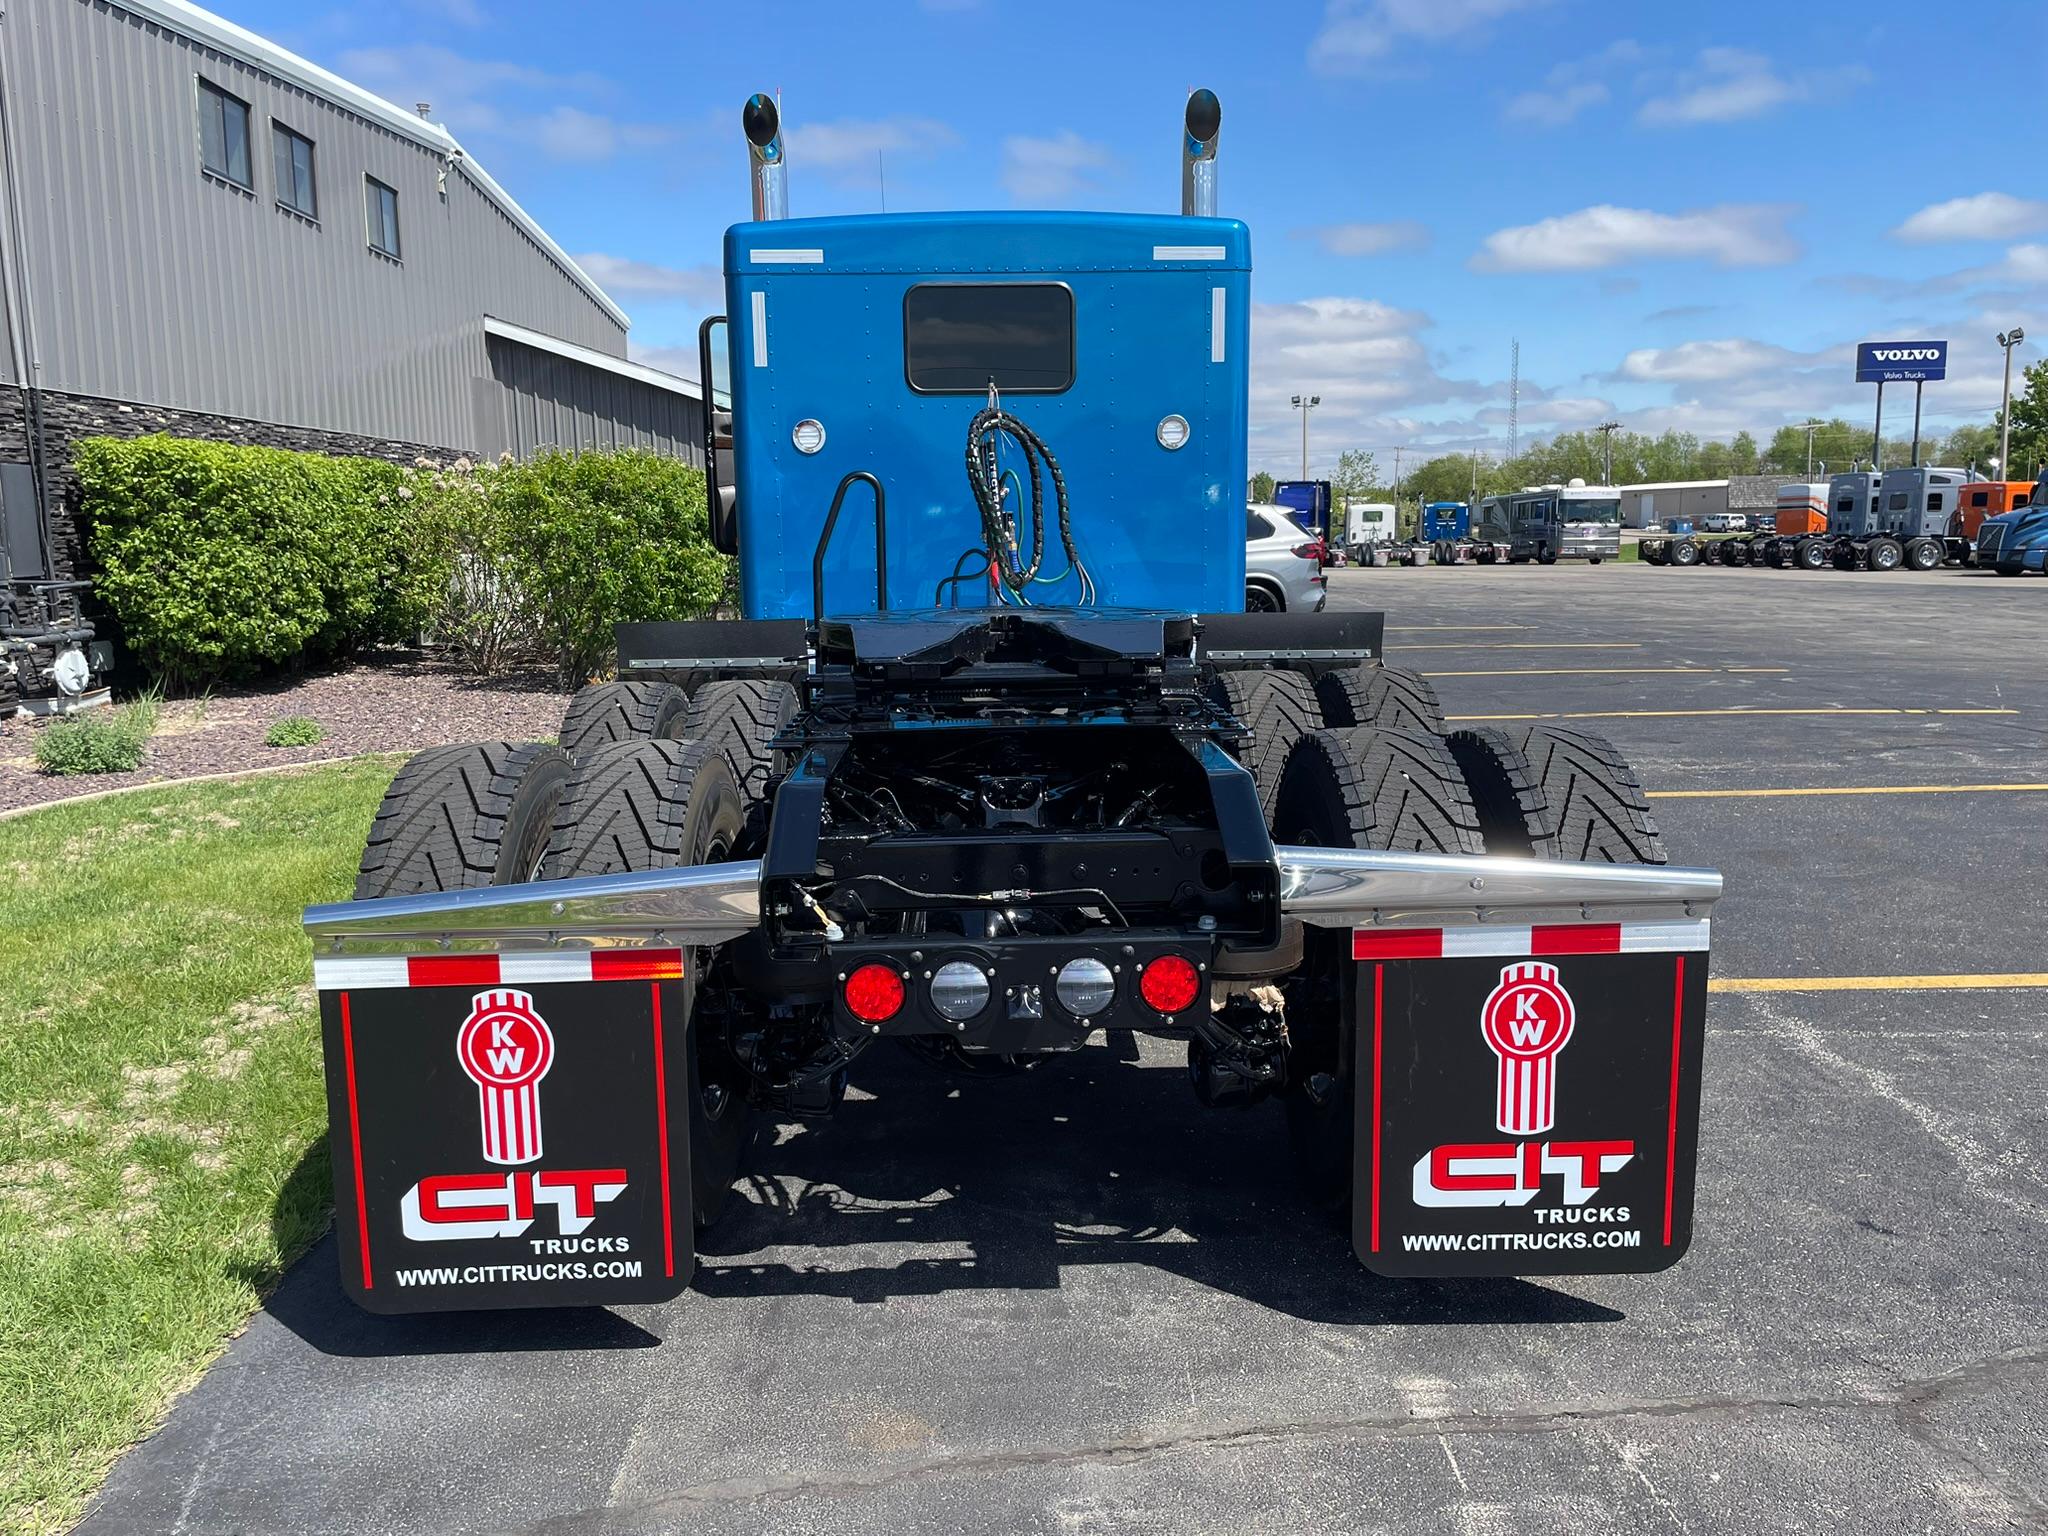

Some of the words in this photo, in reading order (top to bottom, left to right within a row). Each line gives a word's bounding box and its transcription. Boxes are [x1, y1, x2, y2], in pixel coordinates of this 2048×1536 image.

[1872, 349, 1940, 361] VOLVO
[1904, 371, 1926, 379] Trucks
[1516, 993, 1540, 1020] K
[491, 1021, 518, 1048] K
[1508, 1020, 1547, 1047] W
[485, 1047, 525, 1075] W
[1413, 1140, 1635, 1208] CIT
[401, 1169, 628, 1241] CIT
[1533, 1206, 1631, 1225] TRUCKS
[530, 1236, 630, 1255] TRUCKS
[1402, 1230, 1641, 1252] WWW.CITTRUCKS.COM
[396, 1260, 643, 1287] WWW.CITTRUCKS.COM
